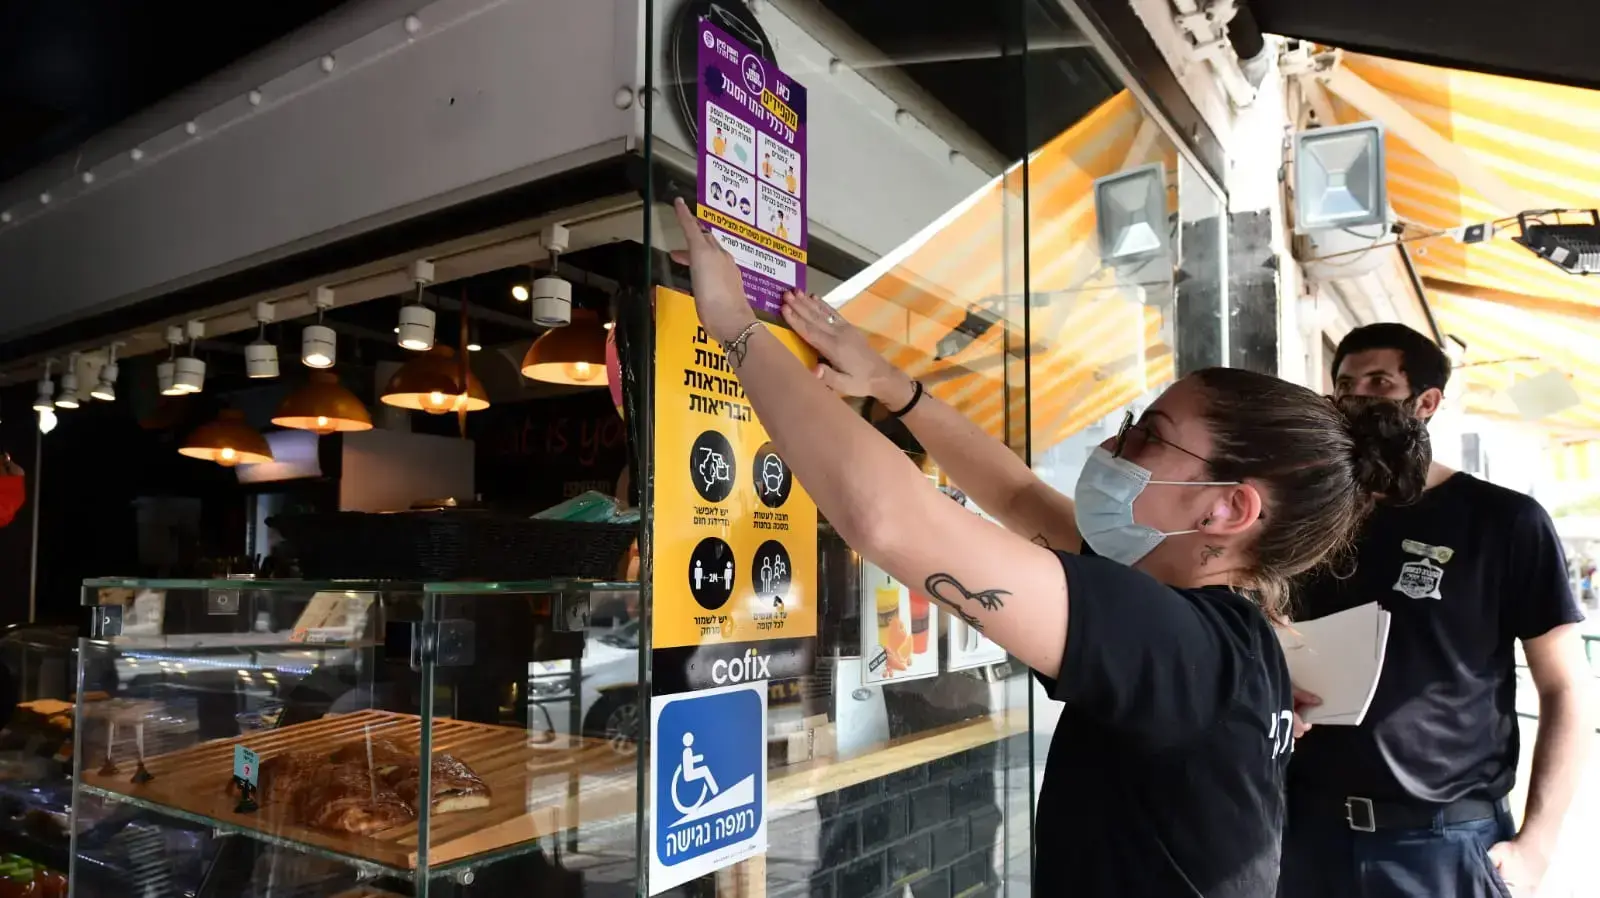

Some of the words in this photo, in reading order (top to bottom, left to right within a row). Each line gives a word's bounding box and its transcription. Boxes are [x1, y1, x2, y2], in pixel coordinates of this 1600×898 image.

[722, 72, 746, 106] הסגול
[776, 79, 790, 101] כאן
[748, 96, 764, 120] התו
[763, 90, 796, 127] מקפידים
[766, 110, 783, 136] כללי
[784, 124, 794, 144] על
[703, 210, 716, 220] חיים
[695, 348, 735, 374] חנות
[690, 394, 752, 422] הבריאות
[694, 506, 718, 516] לאפשר
[694, 516, 706, 526] חום
[708, 516, 730, 526] מדידת
[720, 508, 728, 517] יש
[708, 573, 718, 583] 2M
[694, 614, 717, 624] לשמור
[718, 616, 728, 624] יש
[756, 622, 773, 632] קופה
[774, 620, 784, 628] לכל
[712, 648, 772, 684] cofix
[716, 808, 754, 840] רמפה
[666, 822, 711, 857] נגישה
